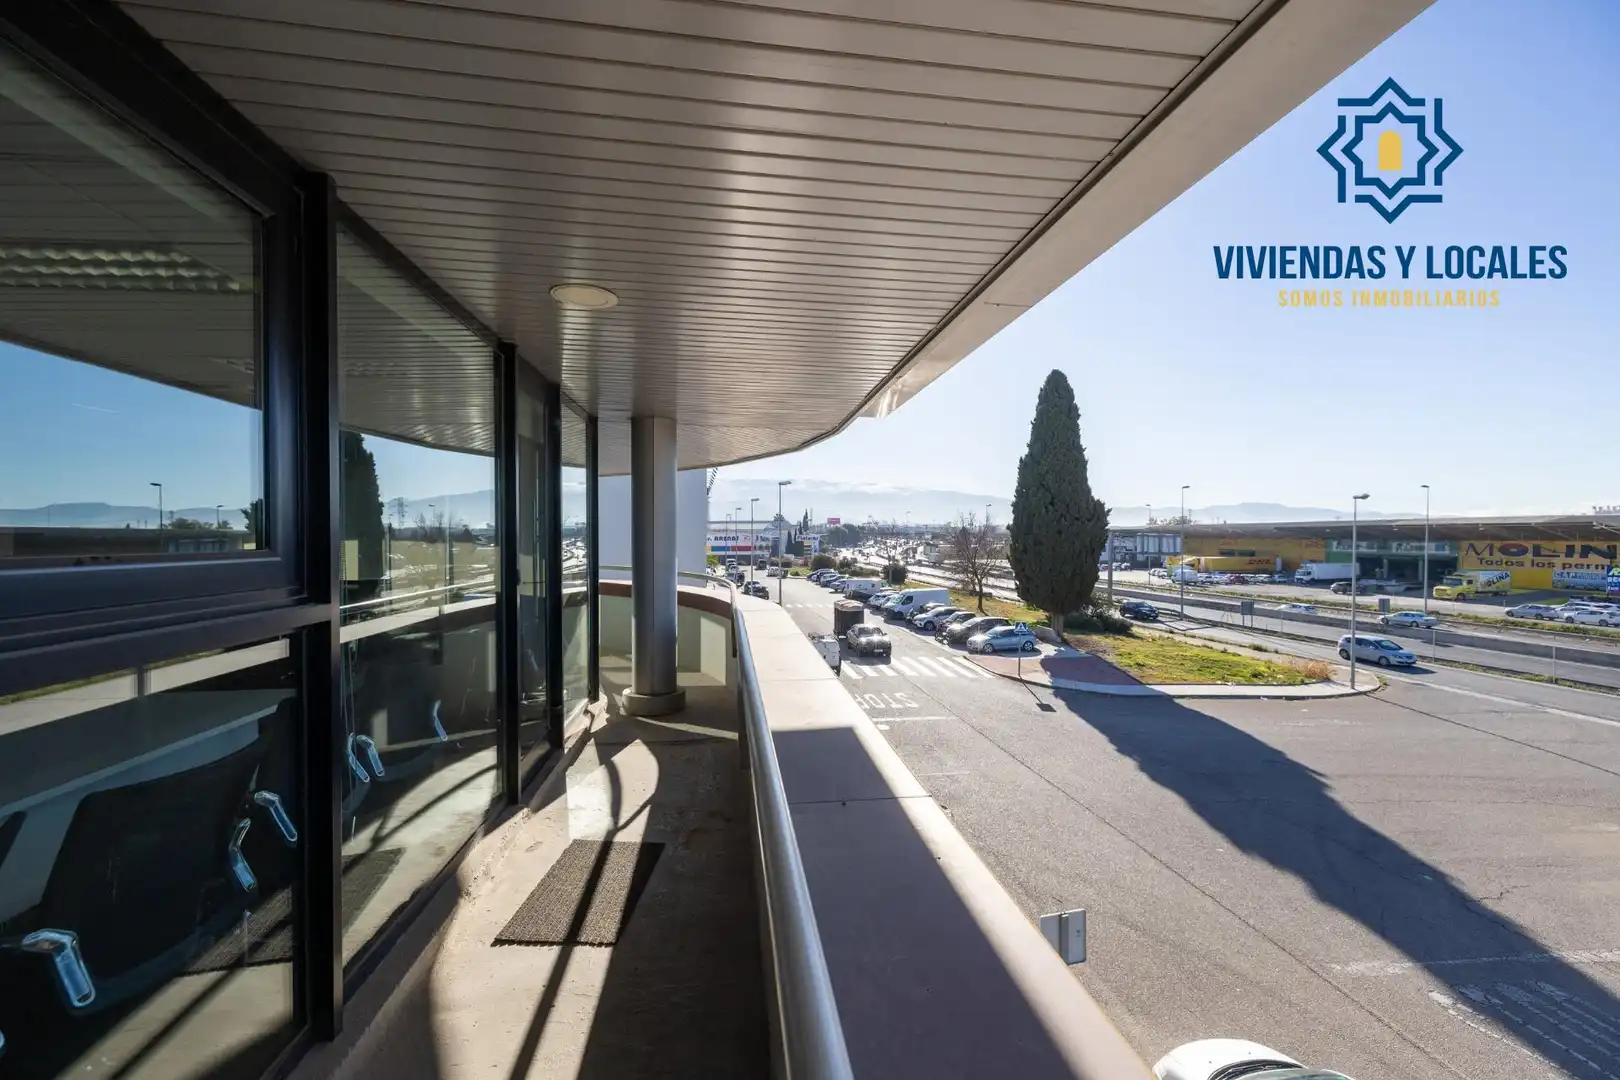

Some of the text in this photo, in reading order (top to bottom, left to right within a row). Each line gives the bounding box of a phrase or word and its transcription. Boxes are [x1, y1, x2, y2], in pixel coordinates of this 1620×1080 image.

[1465, 542, 1618, 560] MOLIN
[1478, 557, 1525, 568] Todos
[1531, 558, 1556, 569] los
[855, 691, 920, 709] STOP
